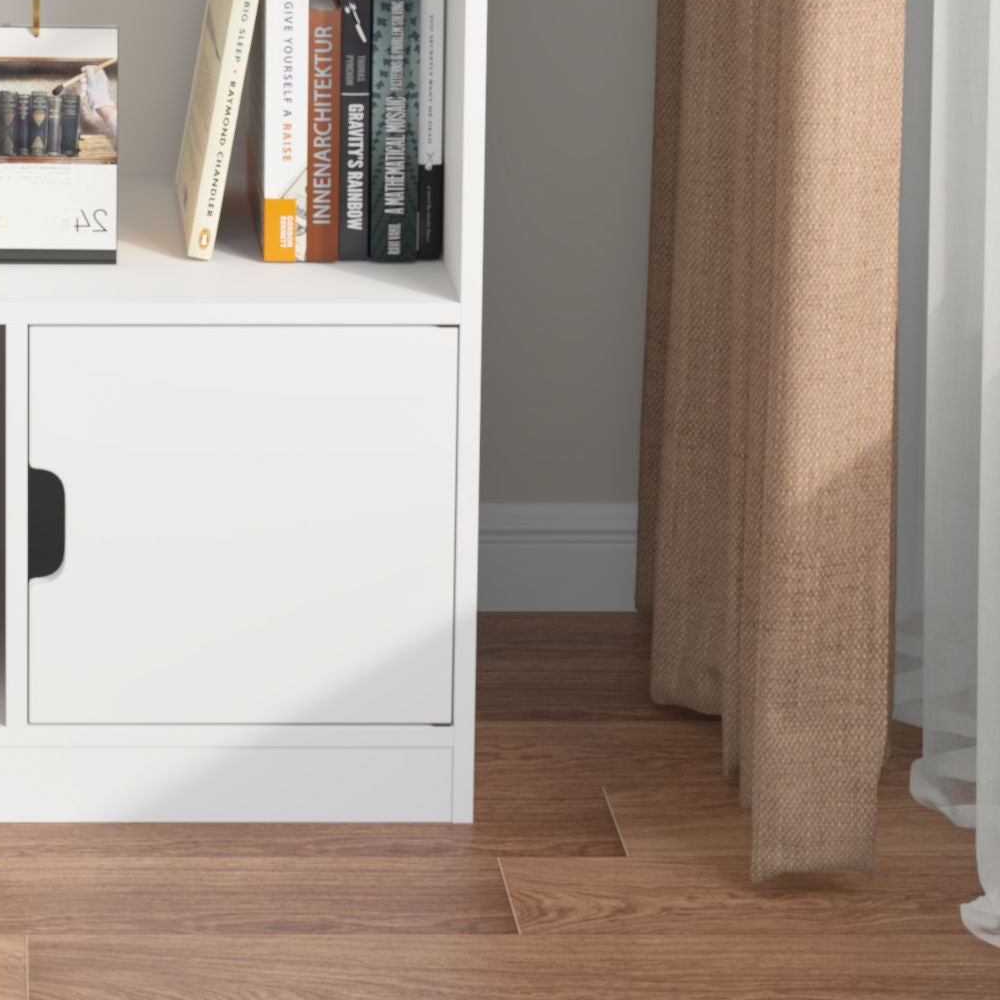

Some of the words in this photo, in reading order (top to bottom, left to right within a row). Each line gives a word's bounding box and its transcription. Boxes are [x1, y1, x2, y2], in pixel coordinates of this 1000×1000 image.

[241, 1, 250, 22] BIG
[283, 1, 294, 32] GIVE
[234, 28, 246, 63] SLEEP
[283, 38, 294, 103] YOURSELF
[219, 80, 237, 146] RAYMOND
[283, 109, 292, 118] A
[312, 26, 333, 225] INNENARCHITEKTUR
[347, 103, 364, 169] GRAVITY'S
[385, 96, 406, 133] MOSAIC
[282, 123, 292, 162] RAISE
[206, 151, 224, 217] CHANDLER
[384, 136, 406, 206] MATHEMATICAL
[347, 171, 363, 231] RAINBOW
[384, 207, 404, 215] A
